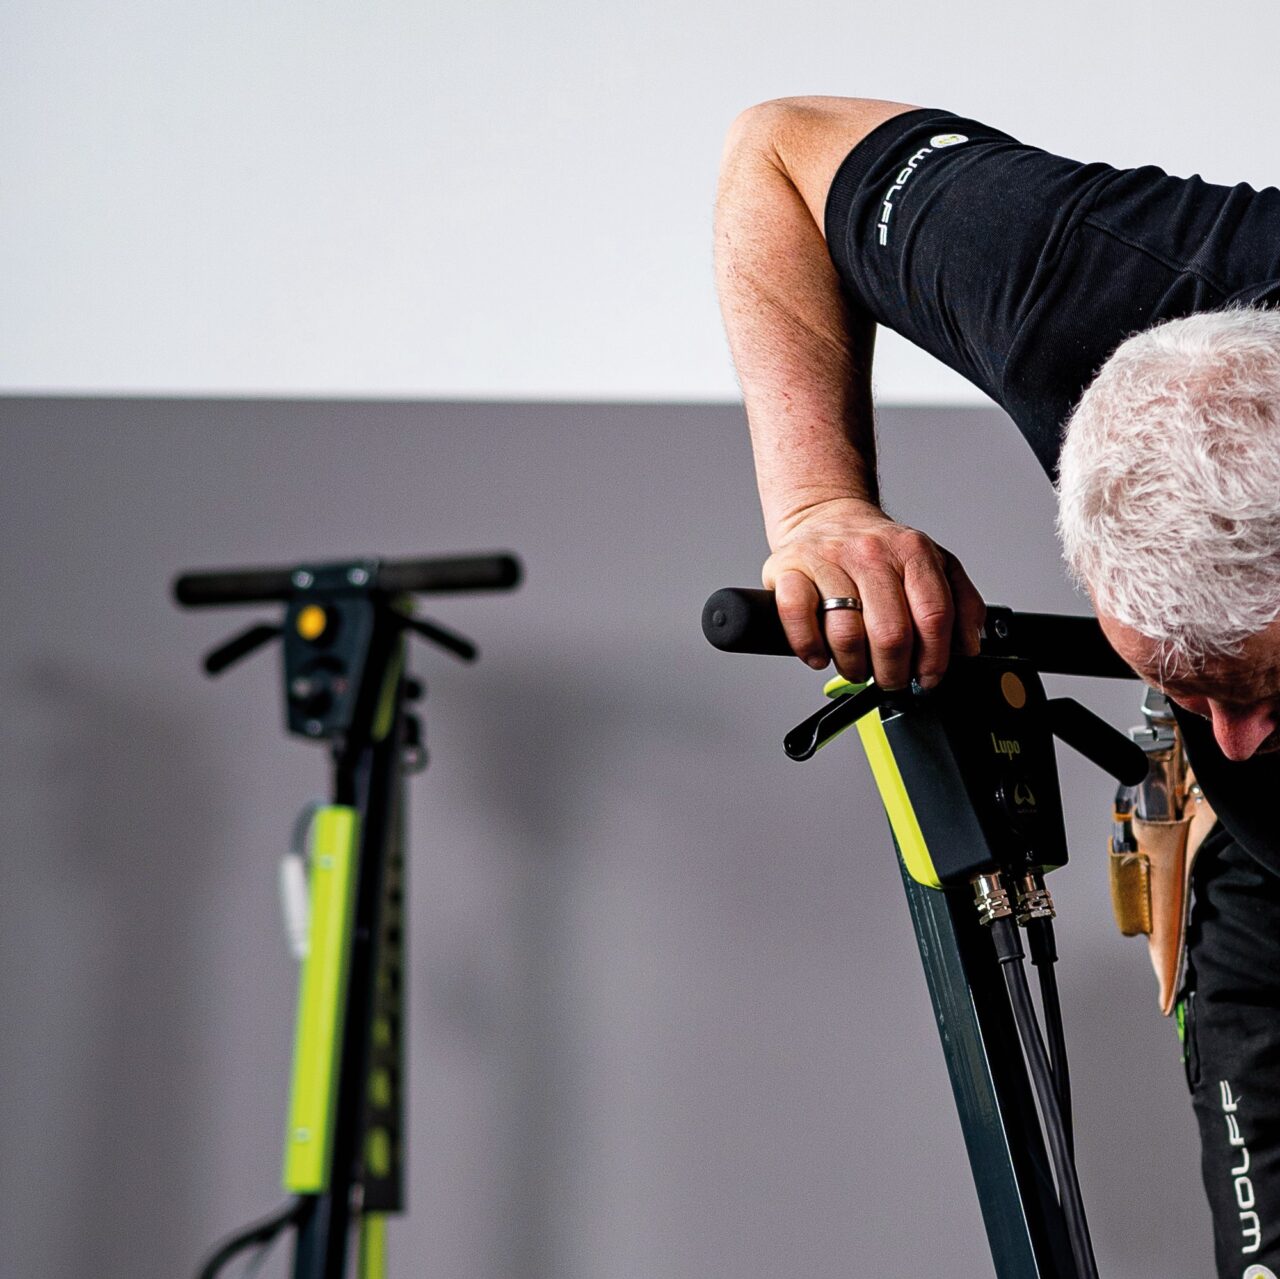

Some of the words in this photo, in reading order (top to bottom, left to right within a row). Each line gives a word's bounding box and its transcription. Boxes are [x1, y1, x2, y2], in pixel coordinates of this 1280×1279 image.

[877, 147, 934, 247] WOLFF
[990, 731, 1021, 761] Lupo
[1219, 1079, 1262, 1254] WOLFF
